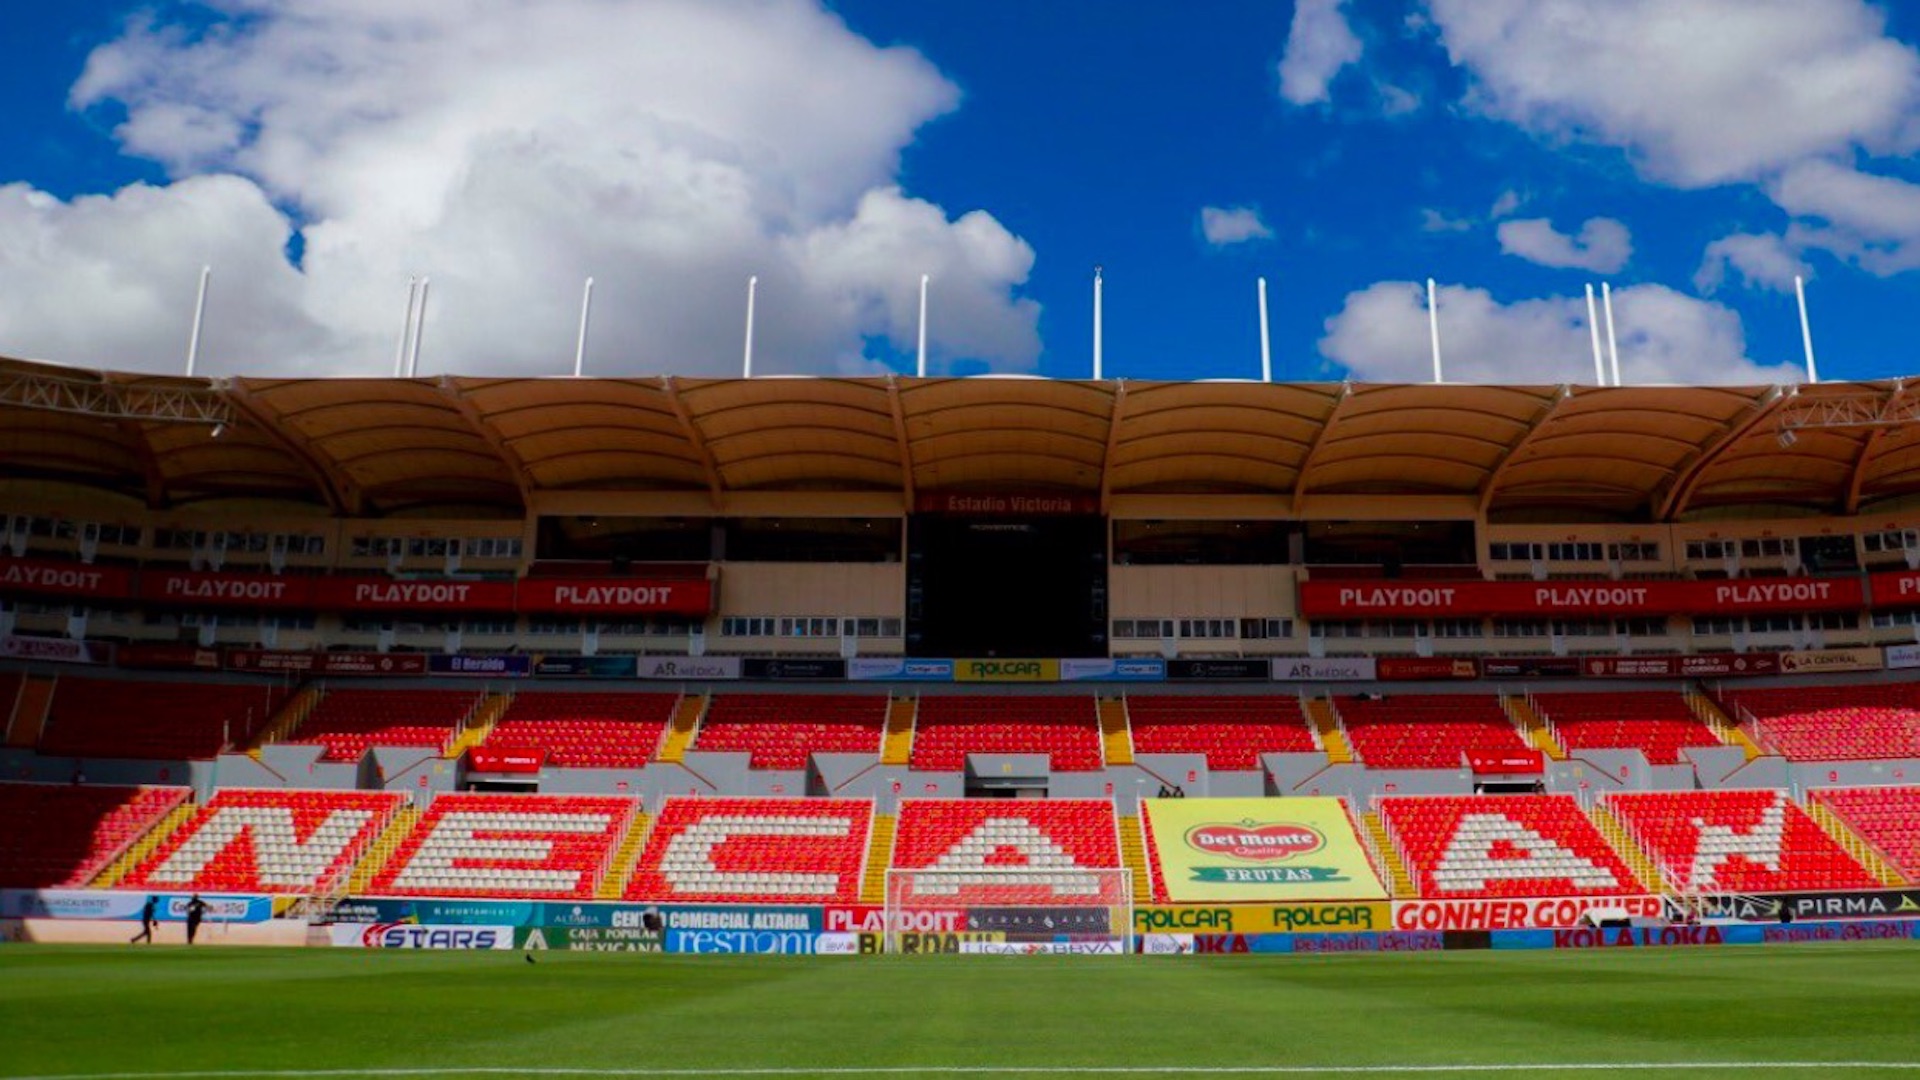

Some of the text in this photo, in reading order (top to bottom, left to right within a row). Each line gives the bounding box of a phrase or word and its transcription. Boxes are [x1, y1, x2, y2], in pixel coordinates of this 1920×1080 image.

[949, 495, 1072, 511] Estadio Victoria
[166, 577, 286, 599] PLAYDOIT
[355, 583, 470, 602] PLAYDOIT
[554, 586, 672, 605] PLAYDOIT
[1716, 582, 1831, 603] PLAYDOIT
[1339, 588, 1455, 607] PLAYDOIT
[1535, 587, 1648, 607] PLAYDOIT
[463, 656, 506, 671] Heraldo
[654, 662, 677, 675] AR
[1814, 655, 1857, 665] CENTRAL
[971, 662, 1041, 678] ROLCAR
[1290, 663, 1312, 677] AR
[1198, 831, 1313, 847] Del Monte
[1235, 846, 1283, 857] Quality
[1224, 868, 1314, 882] FRUTAS
[1797, 897, 1887, 914] PIRMA
[554, 914, 599, 923] ALTARIA
[611, 910, 810, 930] CENTO COMERCIAL ALTARIA
[828, 909, 960, 931] PLAYDOIT
[1132, 908, 1234, 931] ROLCAR
[1273, 906, 1373, 930] ROLCAR
[1396, 902, 1528, 930] GONHER
[384, 929, 497, 949] STARS
[569, 928, 659, 941] CAJA POPULAR
[1554, 925, 1723, 949] KOLA LOKA
[570, 941, 664, 953] MEXICANA
[1052, 943, 1116, 954] BBVA
